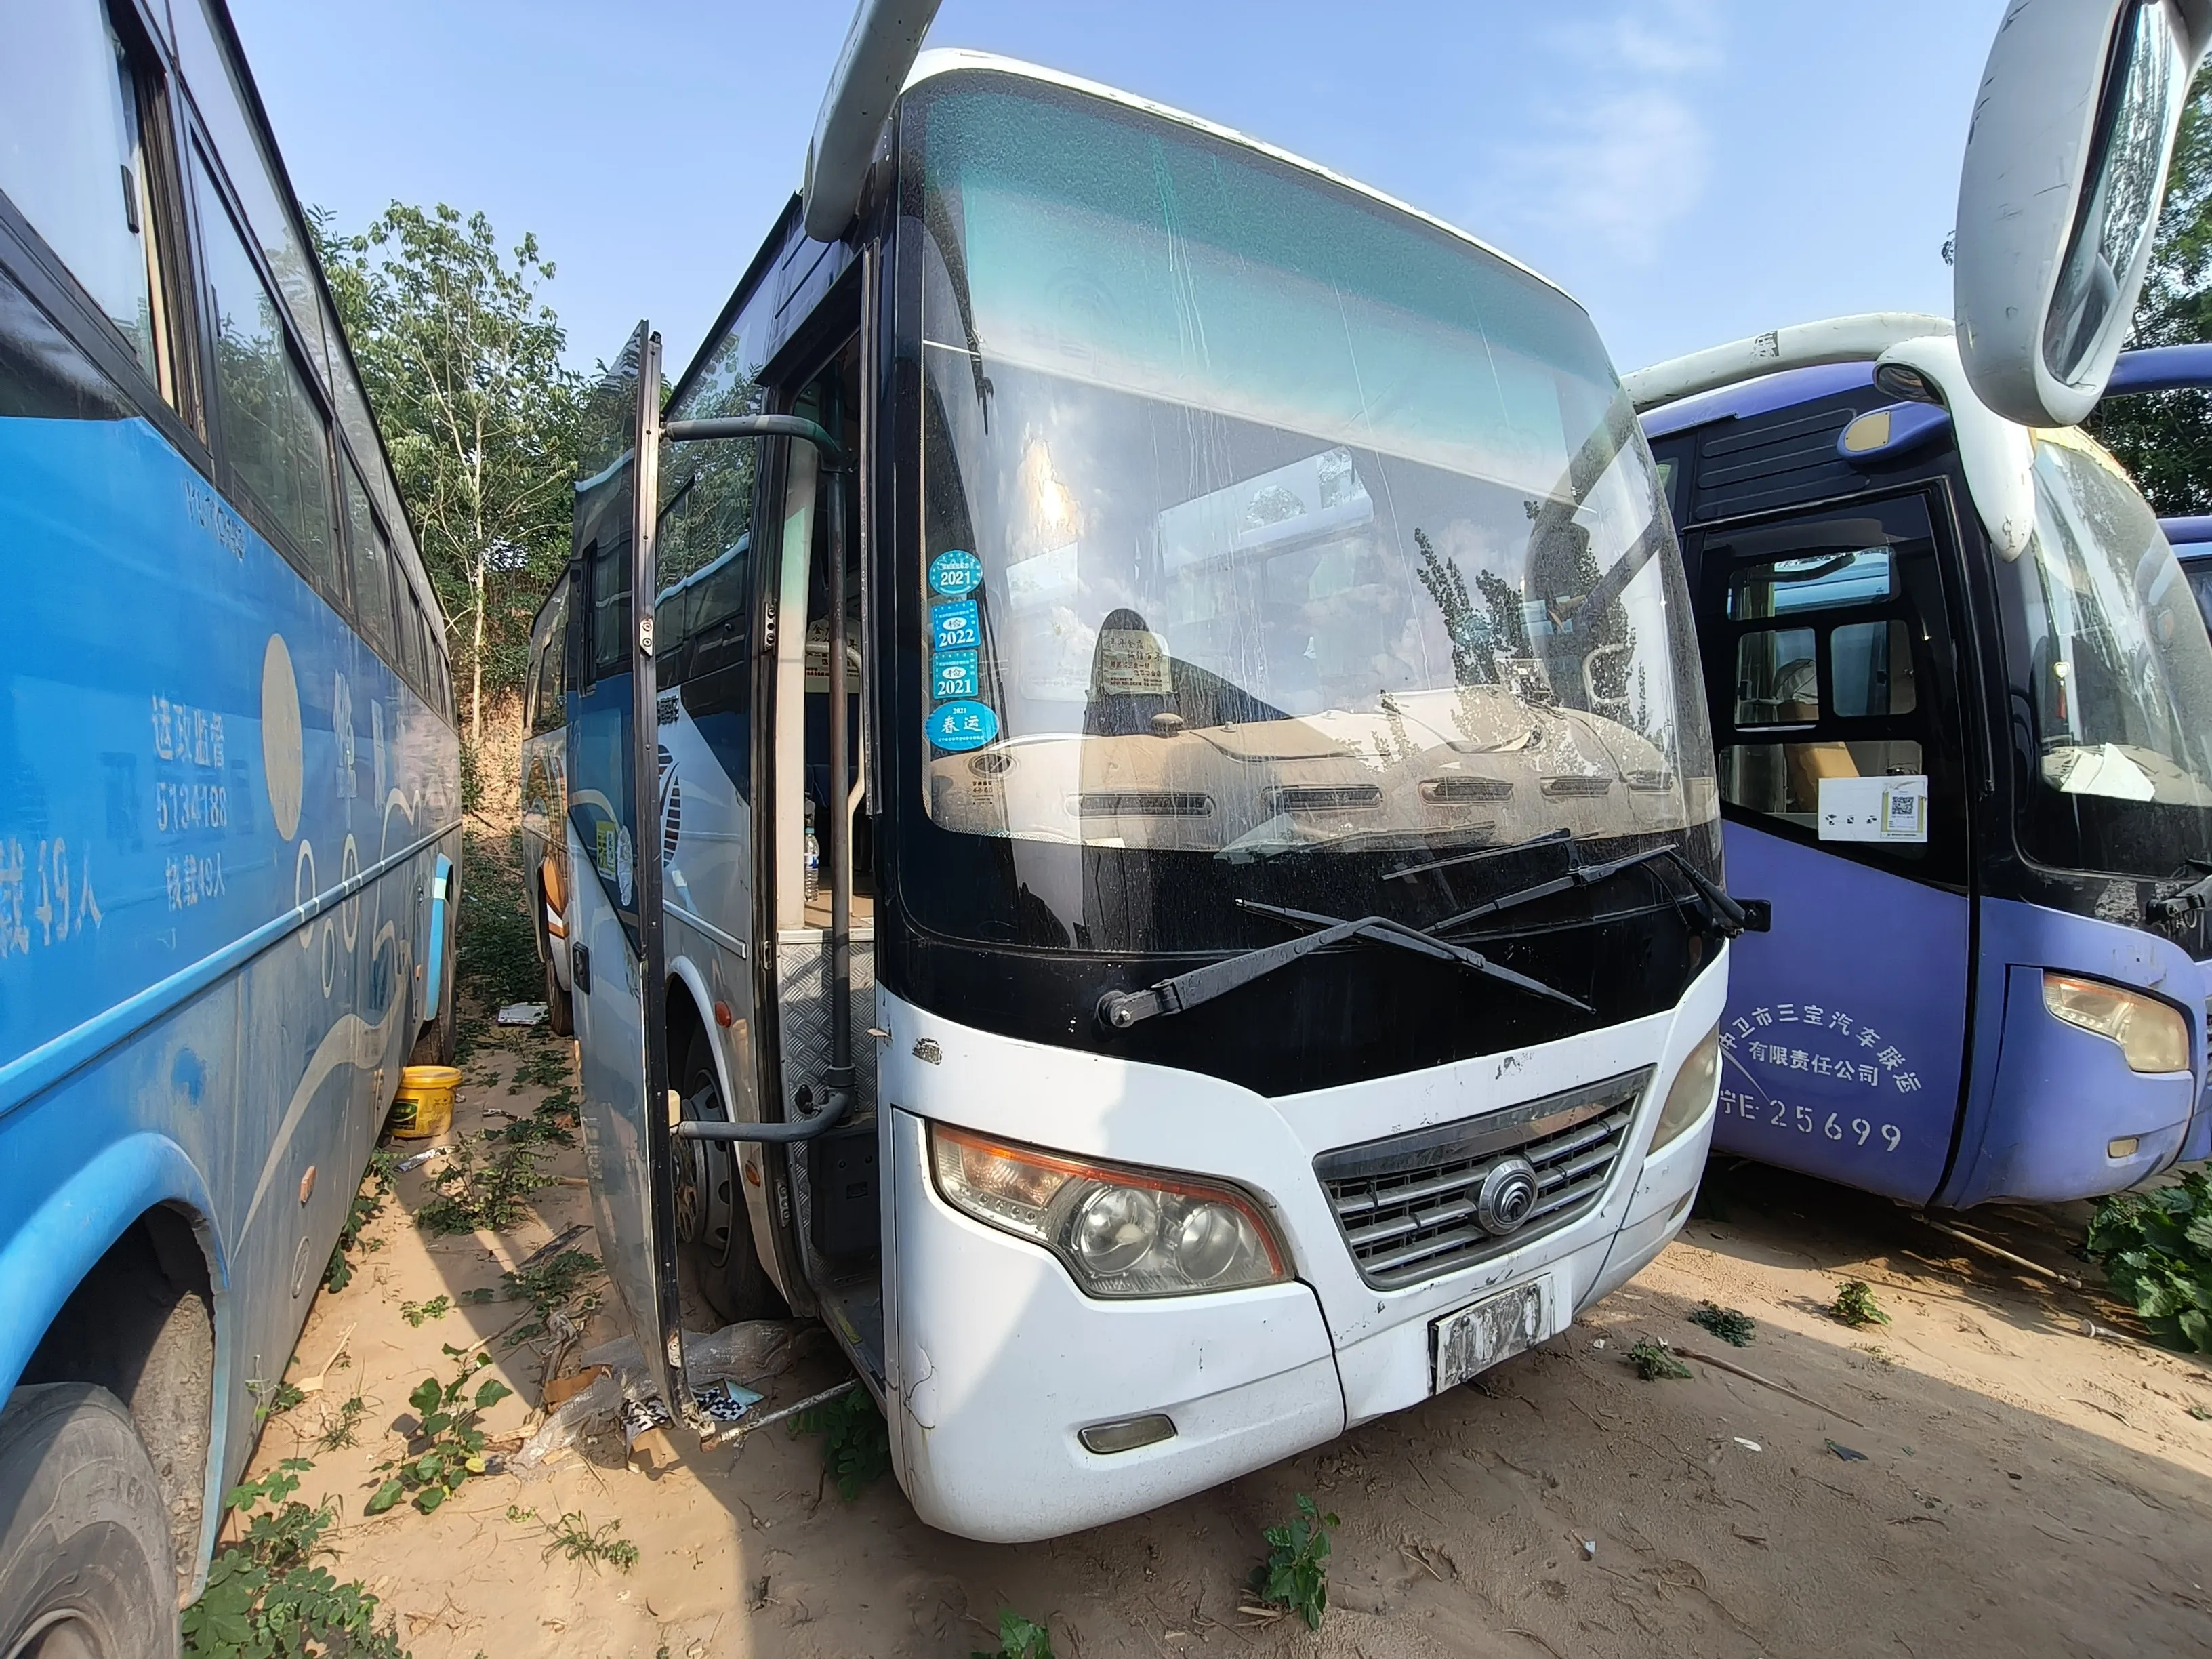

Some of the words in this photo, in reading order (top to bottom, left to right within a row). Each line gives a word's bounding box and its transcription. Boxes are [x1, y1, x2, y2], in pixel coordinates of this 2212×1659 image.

[941, 570, 970, 586] 2021
[939, 628, 975, 647] 2022
[937, 679, 972, 695] 2021
[941, 715, 983, 734] 春运
[1748, 1041, 1879, 1087] 有限责任公司
